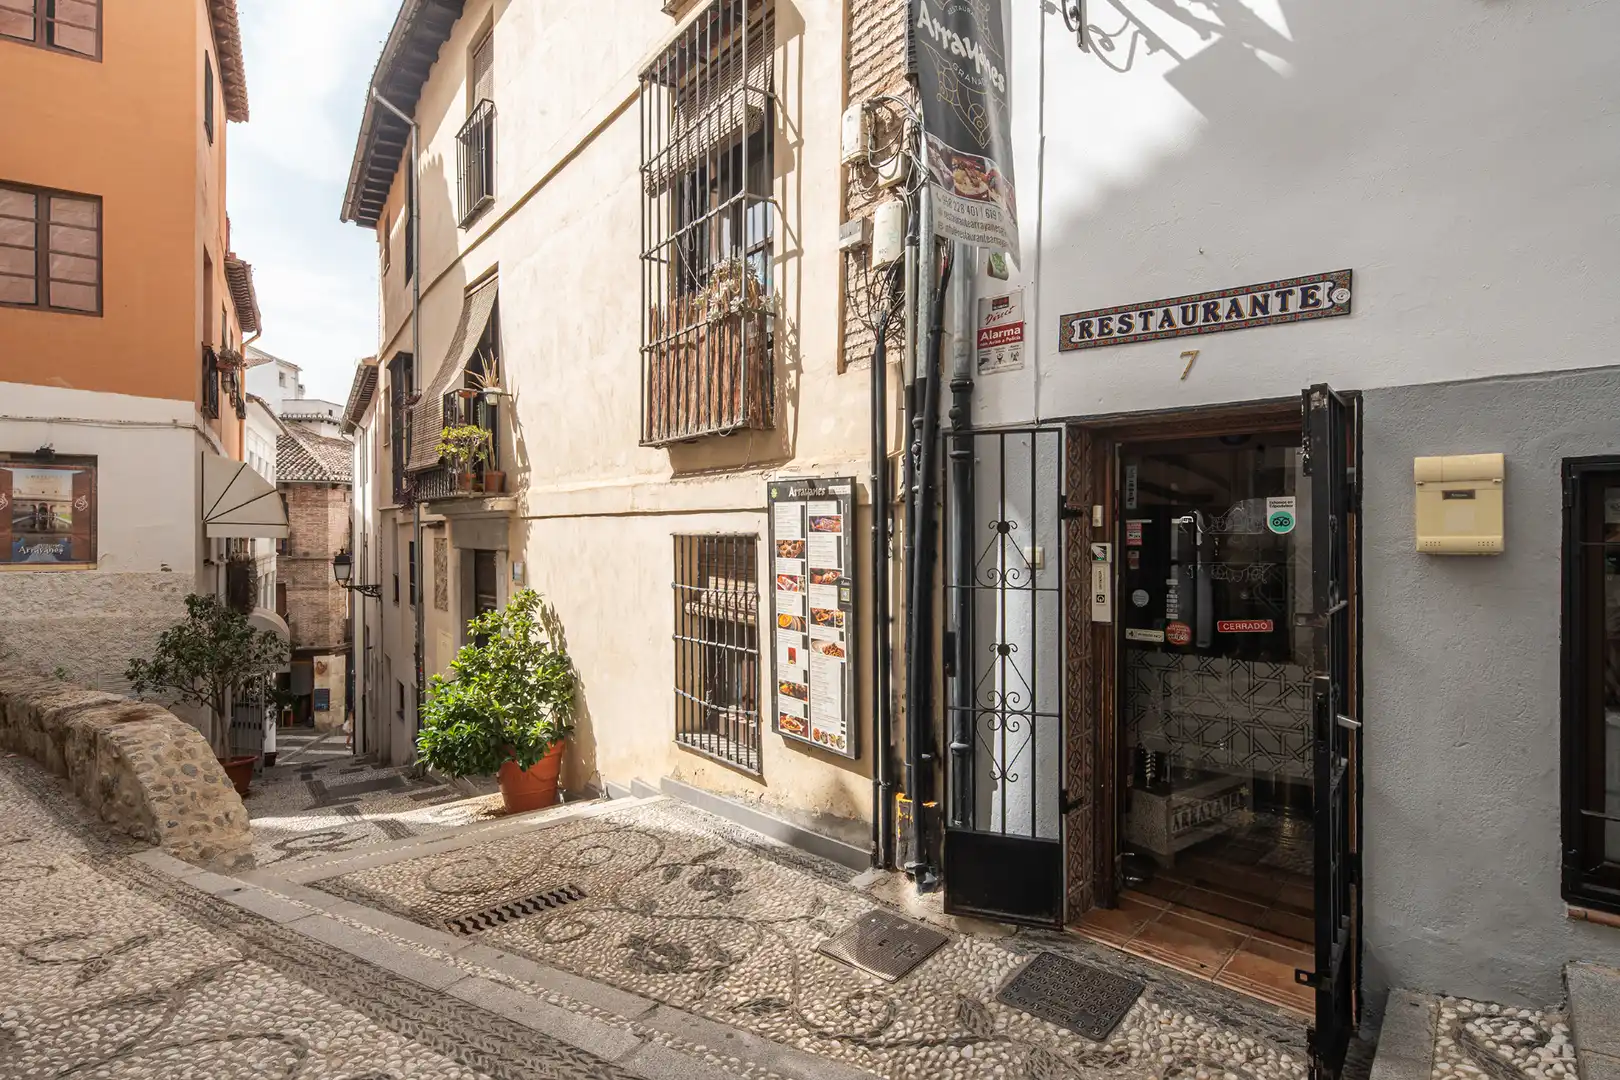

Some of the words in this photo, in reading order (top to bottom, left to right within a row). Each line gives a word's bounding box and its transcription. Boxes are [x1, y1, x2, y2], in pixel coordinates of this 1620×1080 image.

[917, 0, 1005, 93] Arrayanes
[953, 201, 965, 214] 228
[966, 205, 979, 217] 401
[985, 208, 997, 221] 619
[1078, 284, 1323, 340] RESTAURANTE
[980, 327, 1021, 342] Alarma
[1179, 350, 1199, 381] 7
[1222, 622, 1268, 631] CERRADO
